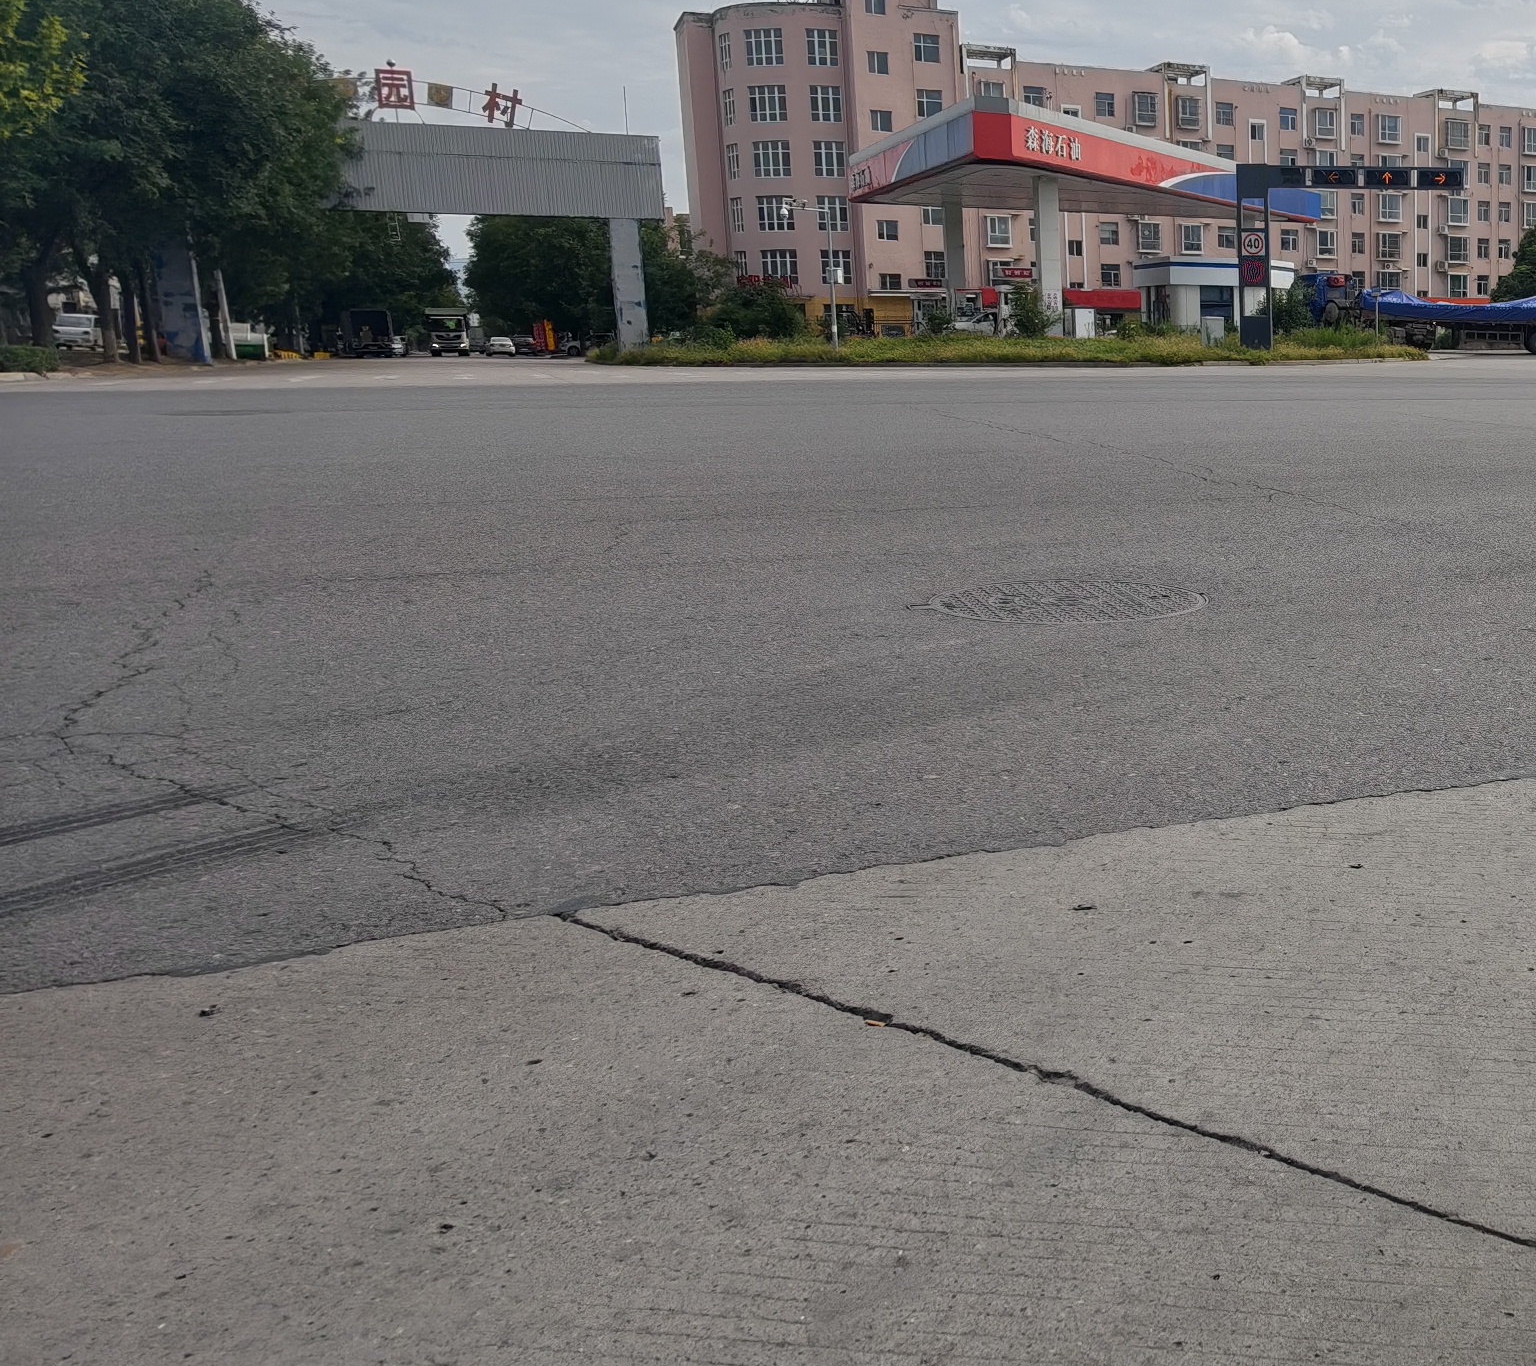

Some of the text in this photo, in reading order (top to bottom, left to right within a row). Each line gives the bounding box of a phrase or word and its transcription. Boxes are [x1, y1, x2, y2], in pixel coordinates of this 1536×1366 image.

[1025, 125, 1082, 162] 森海石油
[1246, 237, 1261, 250] 40
